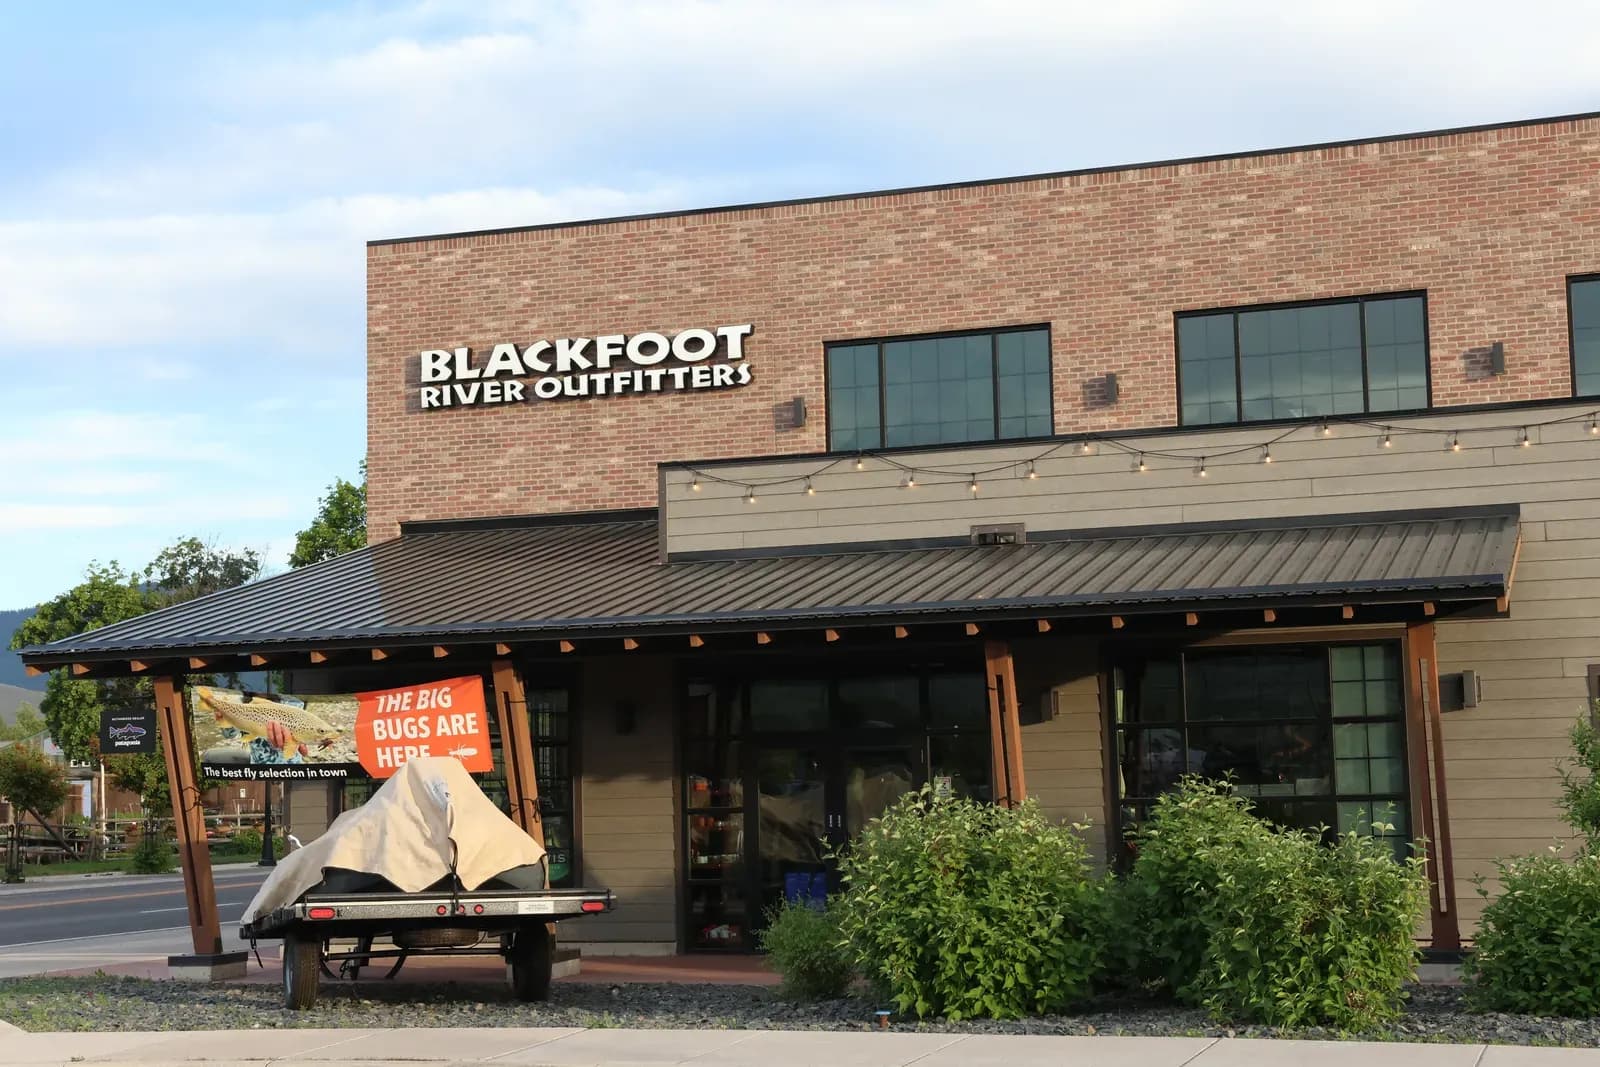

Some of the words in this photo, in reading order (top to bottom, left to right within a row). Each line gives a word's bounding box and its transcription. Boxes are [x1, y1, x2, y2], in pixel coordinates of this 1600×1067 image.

[420, 323, 754, 382] BLACKFOOT
[420, 379, 525, 409] RIVER
[534, 362, 754, 399] OUTFITTERS
[375, 691, 414, 713] THE
[416, 686, 452, 710] BIG
[372, 715, 431, 741] BUGS
[436, 712, 480, 737] ARE
[204, 766, 220, 777] The
[221, 767, 242, 778] best
[244, 767, 257, 780] fly
[258, 767, 305, 778] selection
[306, 767, 317, 779] in
[319, 768, 347, 778] town
